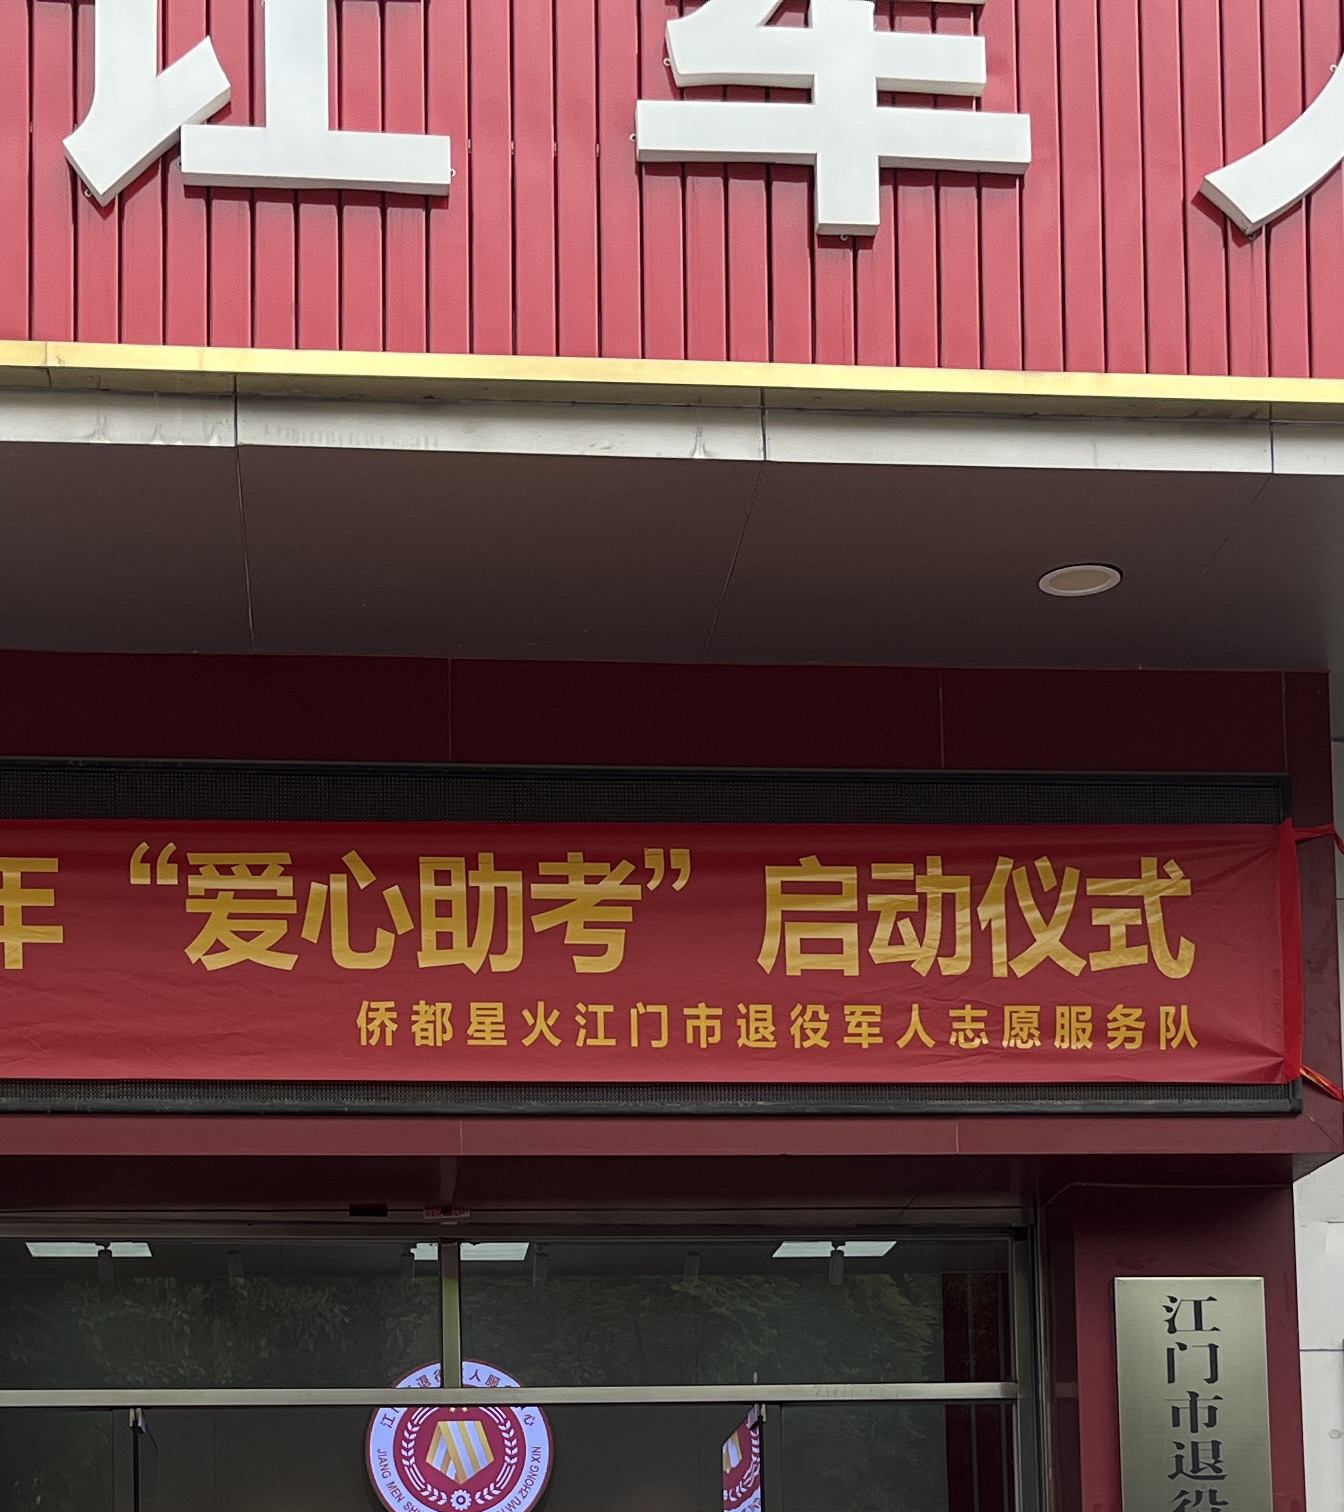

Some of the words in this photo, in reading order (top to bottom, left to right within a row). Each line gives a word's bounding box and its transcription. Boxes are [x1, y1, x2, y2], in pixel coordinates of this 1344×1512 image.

[756, 855, 1196, 980] 启动仪式
[356, 999, 1200, 1051] 侨都星火江门市退役军人志愿服务队
[376, 1447, 392, 1479] JIANG
[385, 1480, 405, 1503] MEN
[520, 1465, 541, 1501] ZHONG
